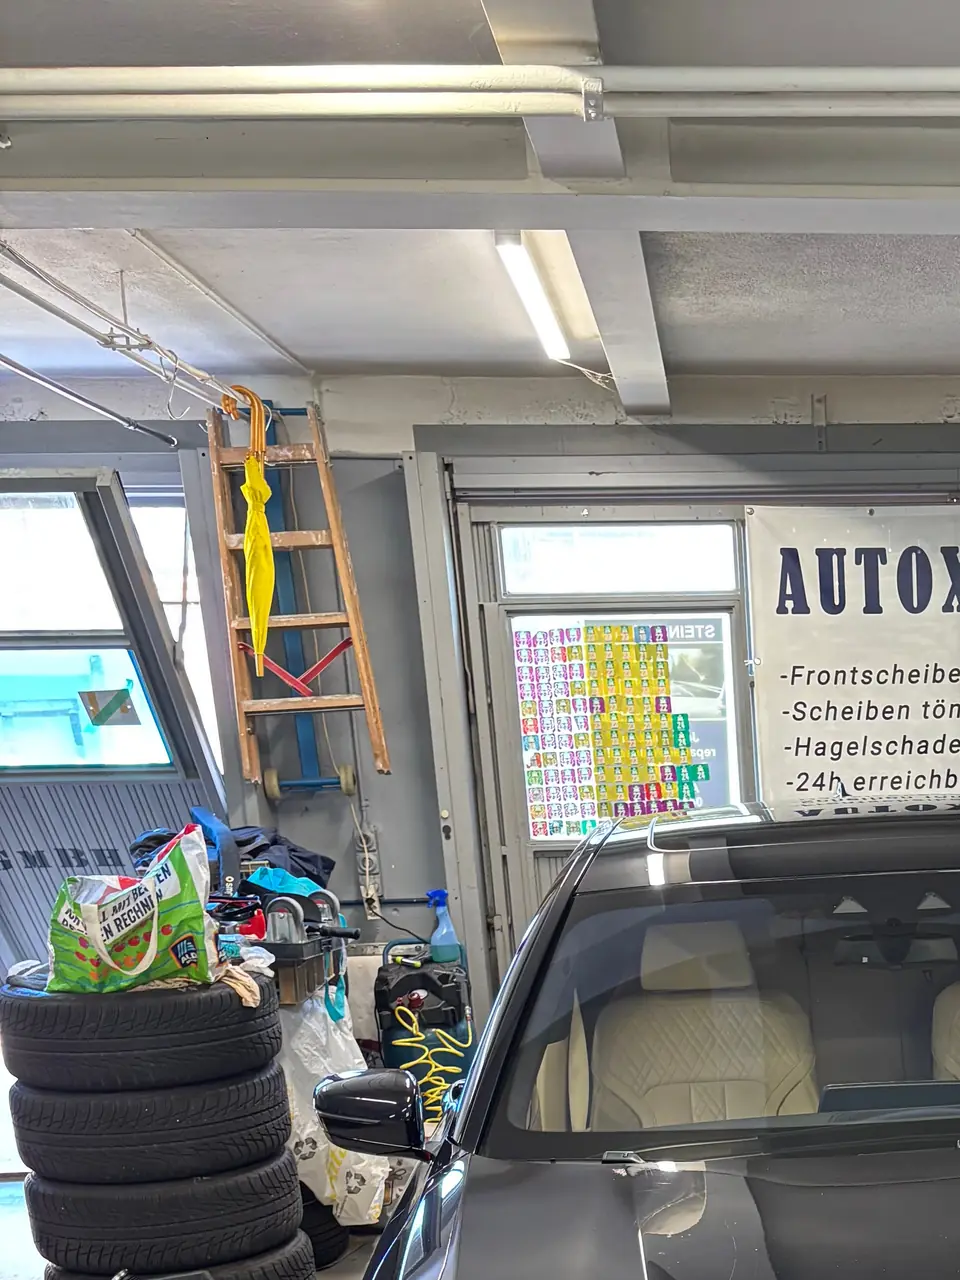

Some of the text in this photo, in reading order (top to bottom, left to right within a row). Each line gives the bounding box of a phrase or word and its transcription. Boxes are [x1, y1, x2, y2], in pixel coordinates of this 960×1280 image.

[780, 663, 960, 686] -Frontscheibe
[782, 700, 910, 722] -Scheiben
[786, 770, 842, 792] -24h
